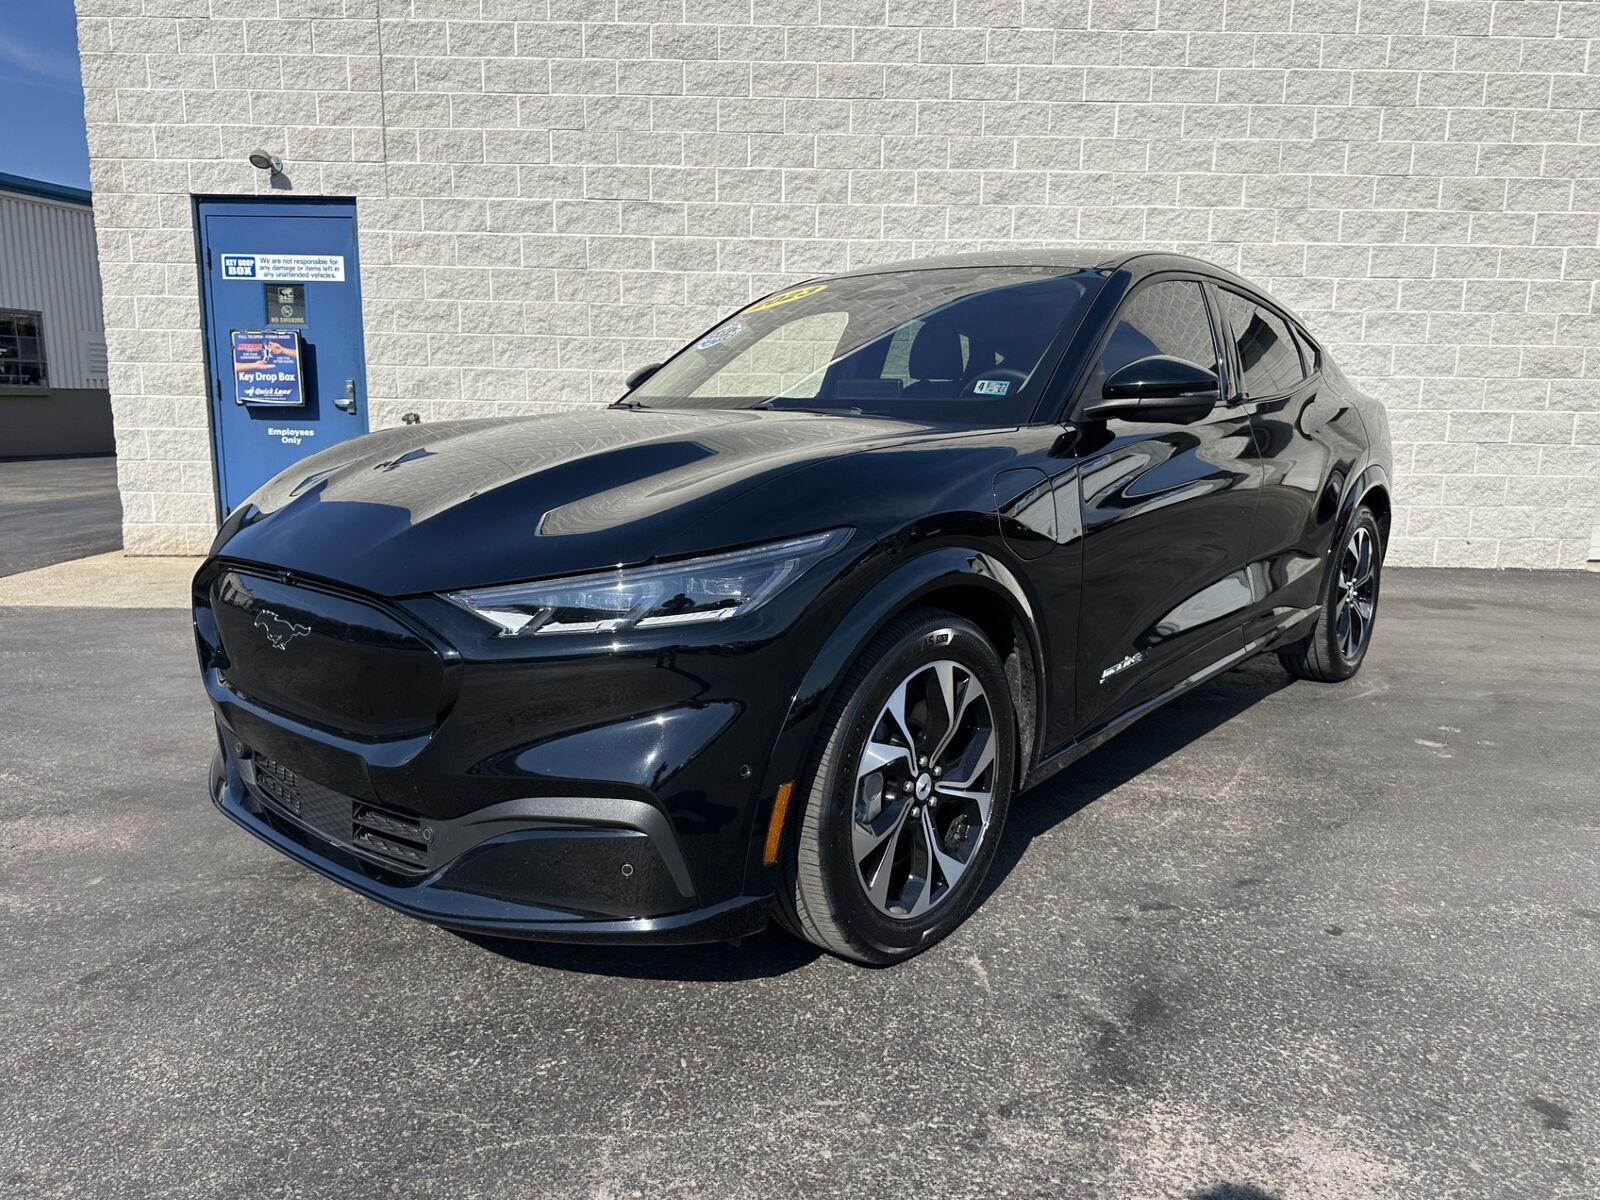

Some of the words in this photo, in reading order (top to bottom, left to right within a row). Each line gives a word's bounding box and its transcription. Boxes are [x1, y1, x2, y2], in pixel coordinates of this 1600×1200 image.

[282, 257, 292, 265] not
[293, 258, 328, 267] responsible
[228, 266, 253, 277] BOX
[272, 264, 296, 272] damage
[322, 264, 333, 272] left
[275, 270, 309, 278] unattended
[310, 271, 336, 279] vehicles.
[239, 372, 254, 383] Key
[255, 371, 277, 383] Drop
[278, 371, 295, 382] Box
[254, 387, 273, 395] Quick
[273, 387, 292, 395] Lane
[978, 381, 985, 392] 4
[268, 428, 314, 436] Employees
[281, 436, 302, 446] Only
